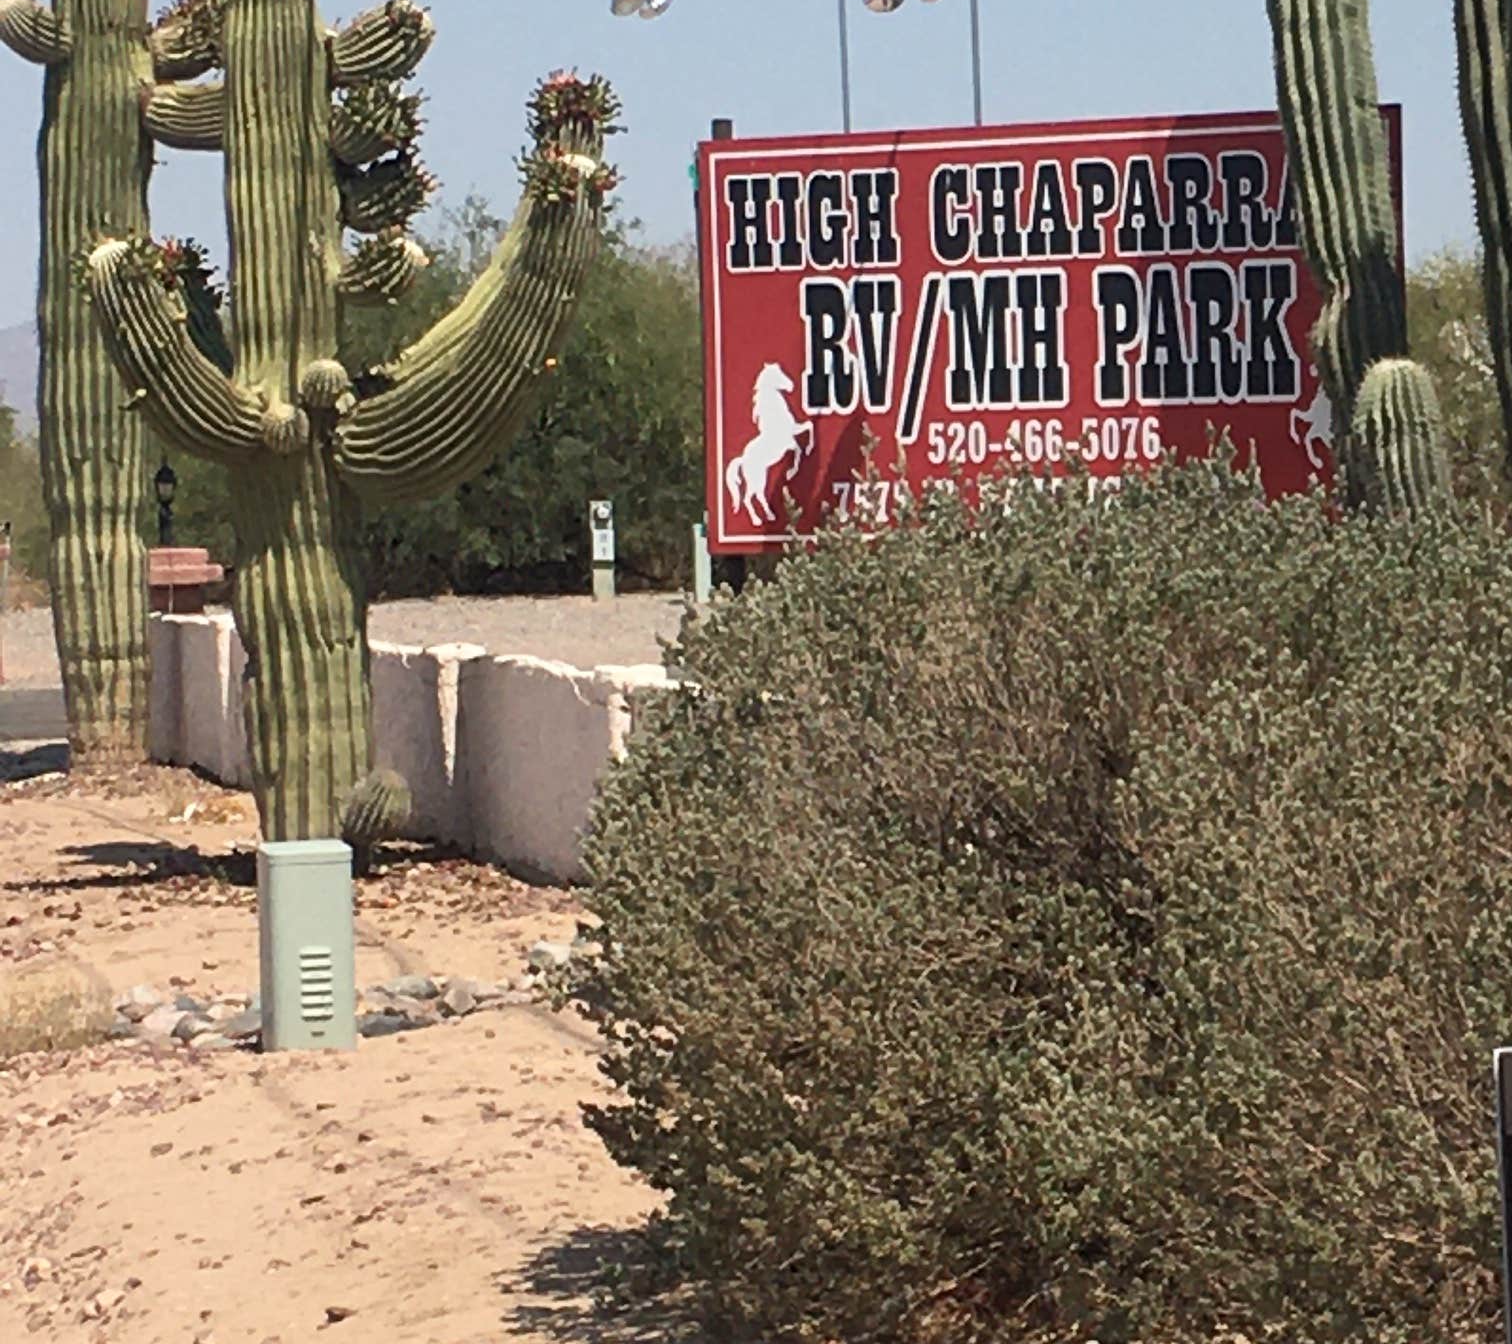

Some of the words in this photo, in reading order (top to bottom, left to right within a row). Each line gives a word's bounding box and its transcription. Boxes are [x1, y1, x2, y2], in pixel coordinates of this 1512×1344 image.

[724, 167, 901, 273] HIGH
[929, 149, 1305, 266] CHAPARRA
[800, 266, 1070, 445] RV/MH
[1091, 259, 1301, 407] PARK
[928, 416, 1162, 464] 520-466-5076
